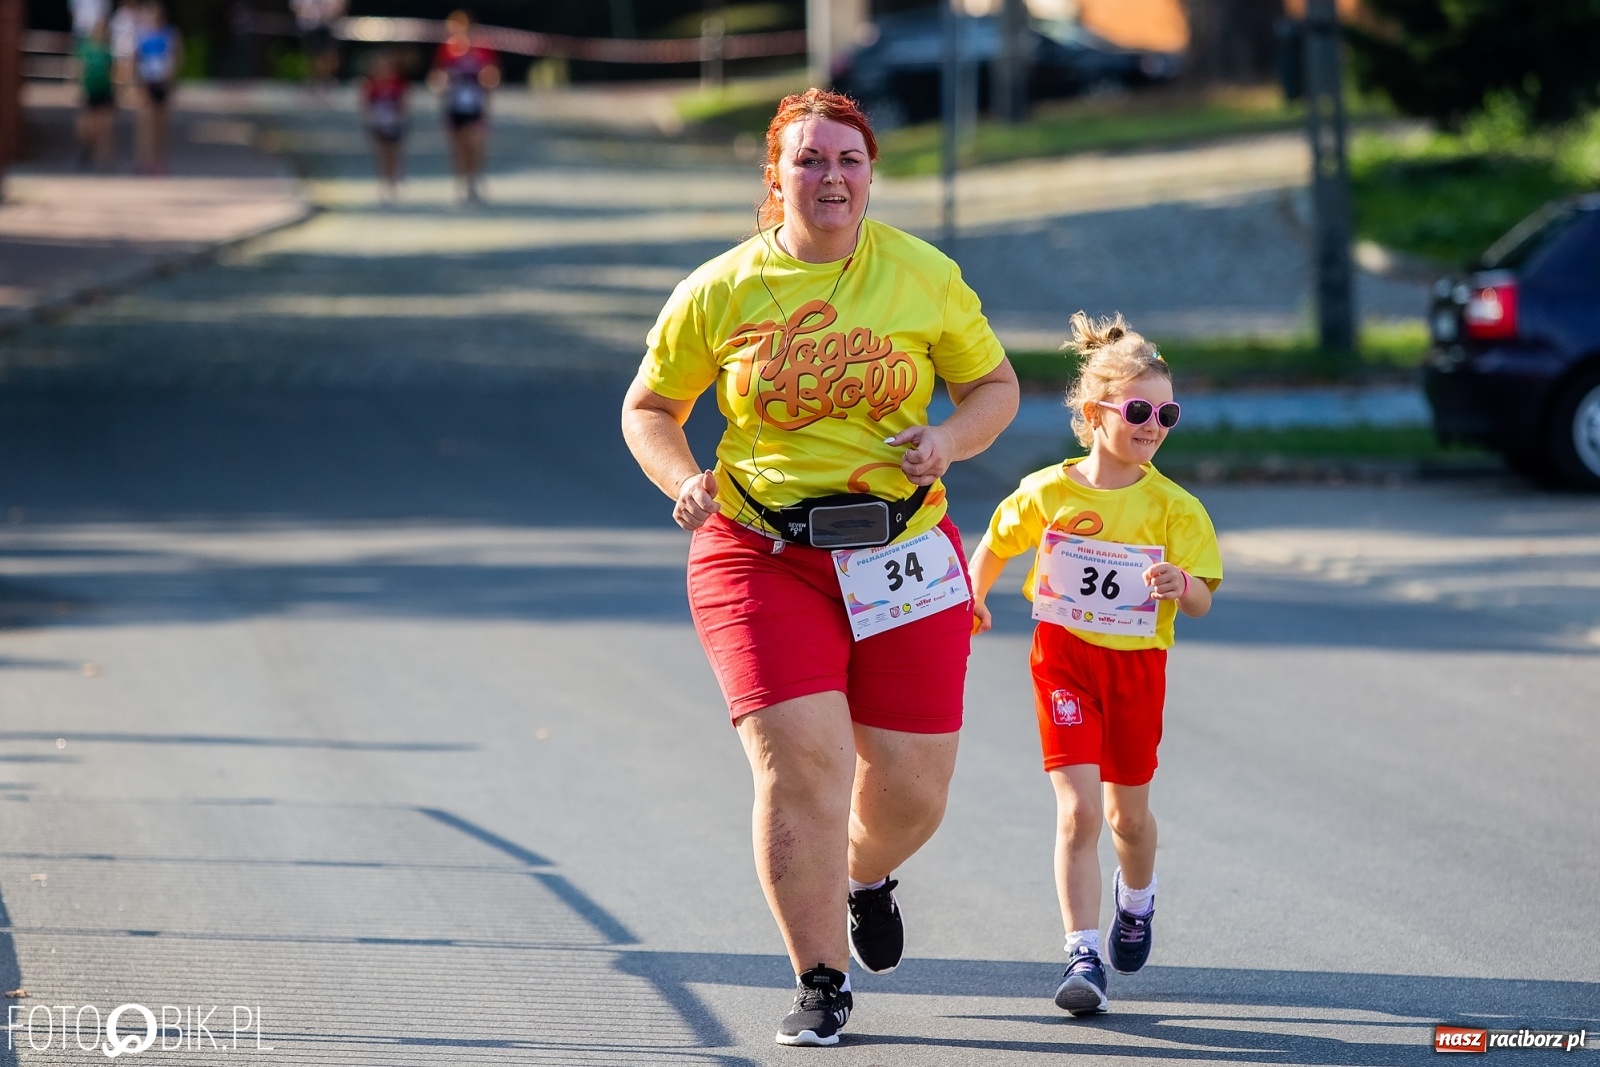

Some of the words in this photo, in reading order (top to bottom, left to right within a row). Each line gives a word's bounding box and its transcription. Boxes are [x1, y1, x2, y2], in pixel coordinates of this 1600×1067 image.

[1077, 546, 1094, 555] MINI
[1096, 550, 1129, 559] RAFAKO
[884, 552, 924, 592] 34
[1080, 567, 1120, 600] 36
